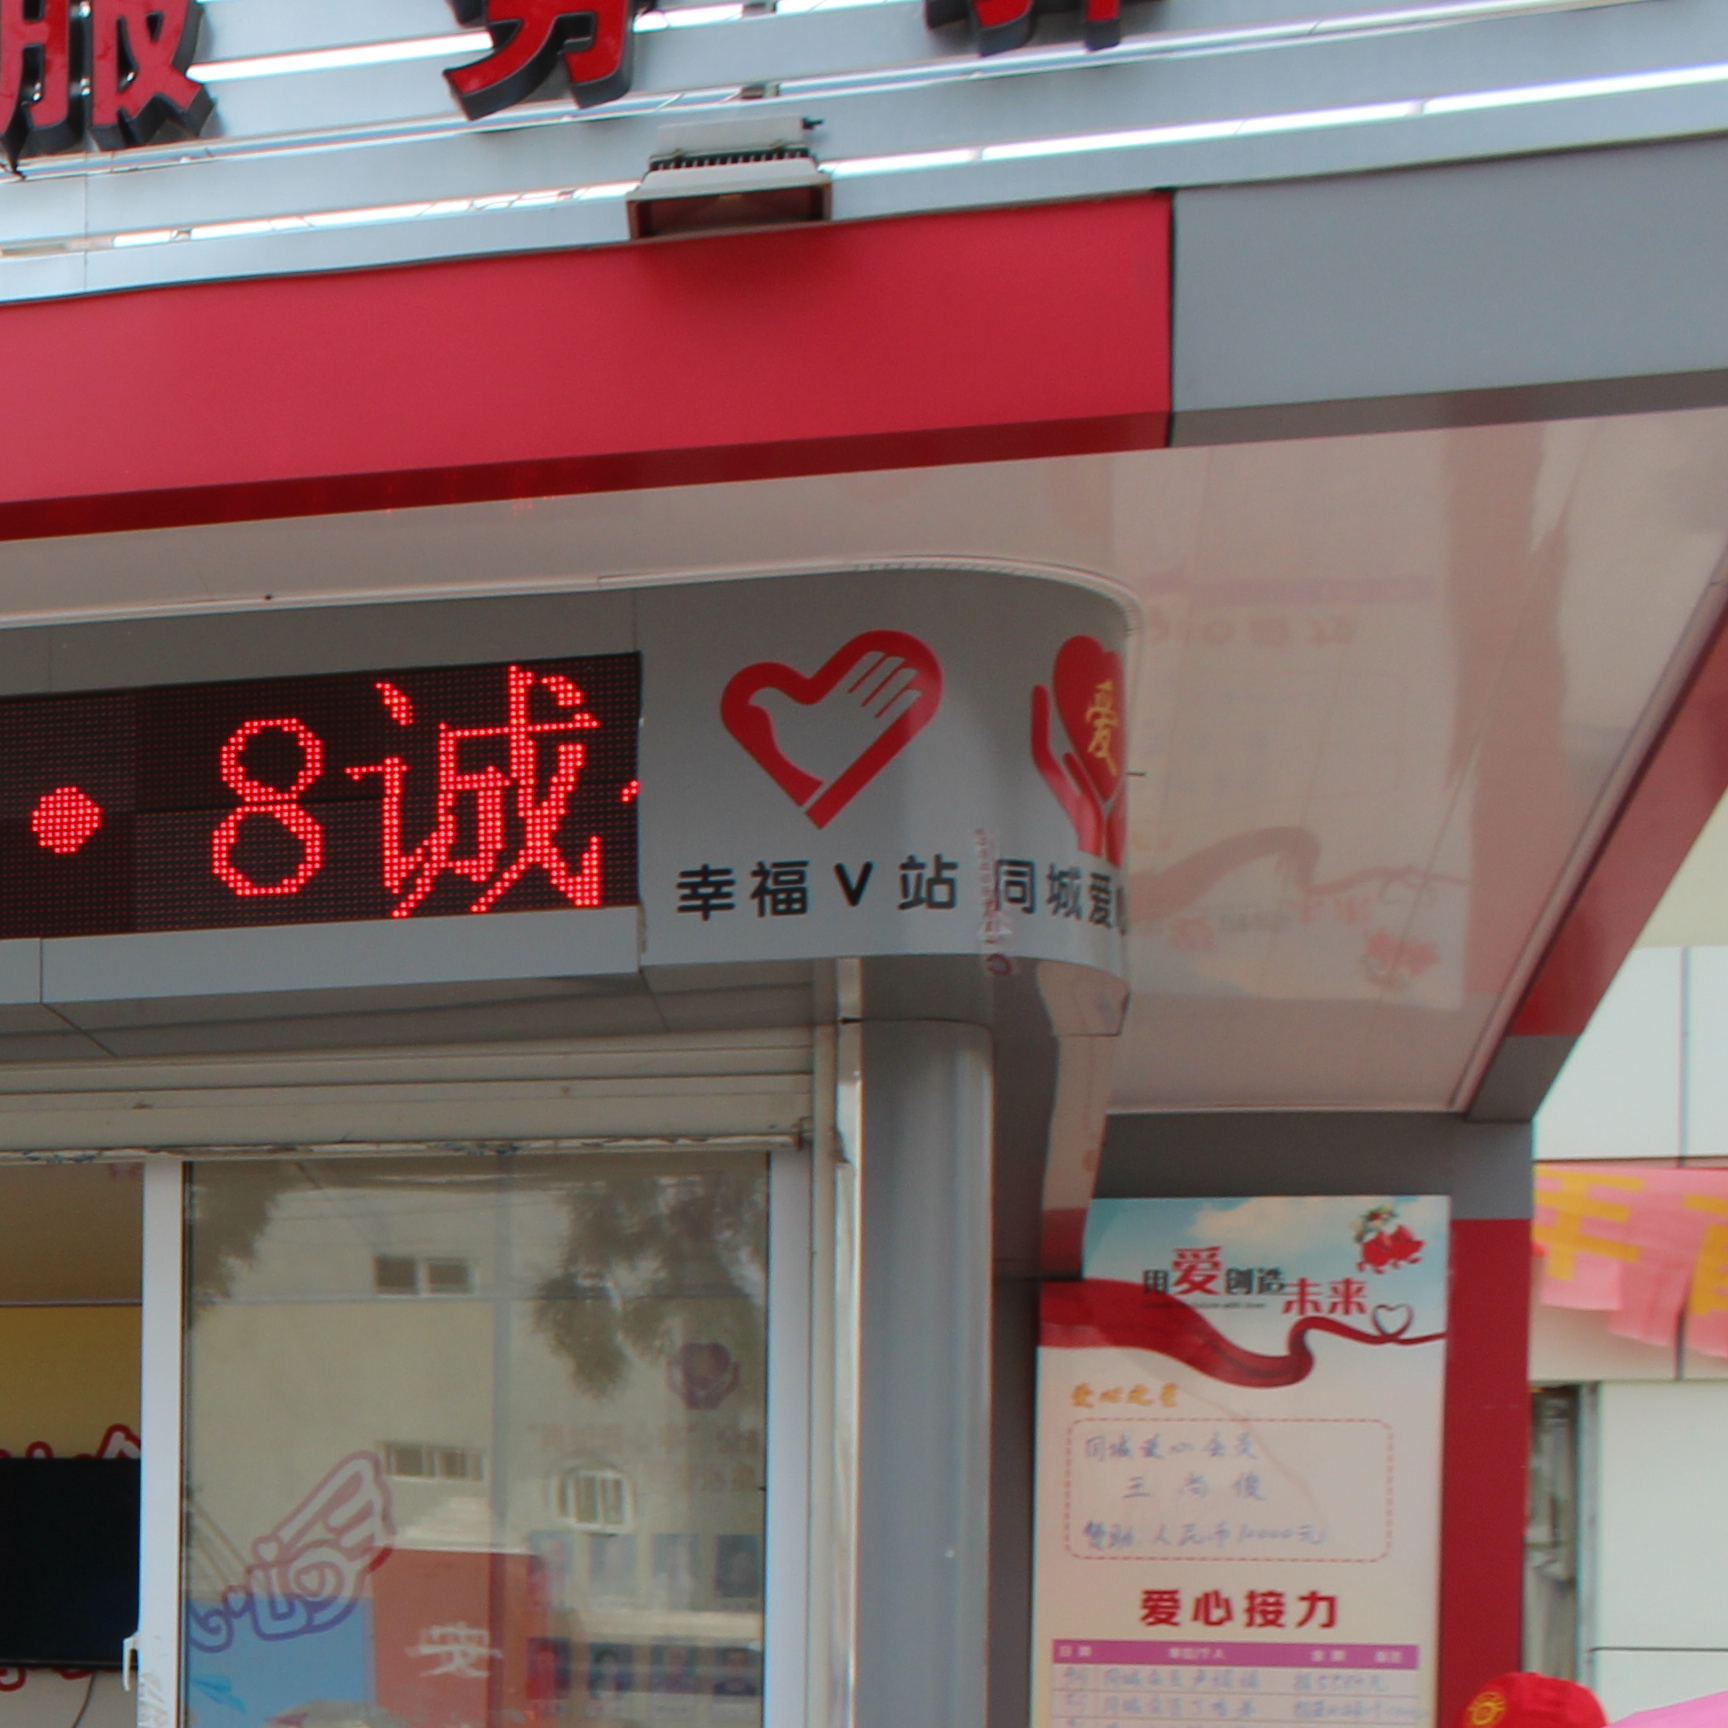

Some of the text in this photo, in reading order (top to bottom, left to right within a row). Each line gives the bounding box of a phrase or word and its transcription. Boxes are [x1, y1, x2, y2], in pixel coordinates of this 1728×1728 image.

[1142, 1245, 1369, 1317] 用爱创造未来
[1139, 1587, 1339, 1630] 爱心接力
